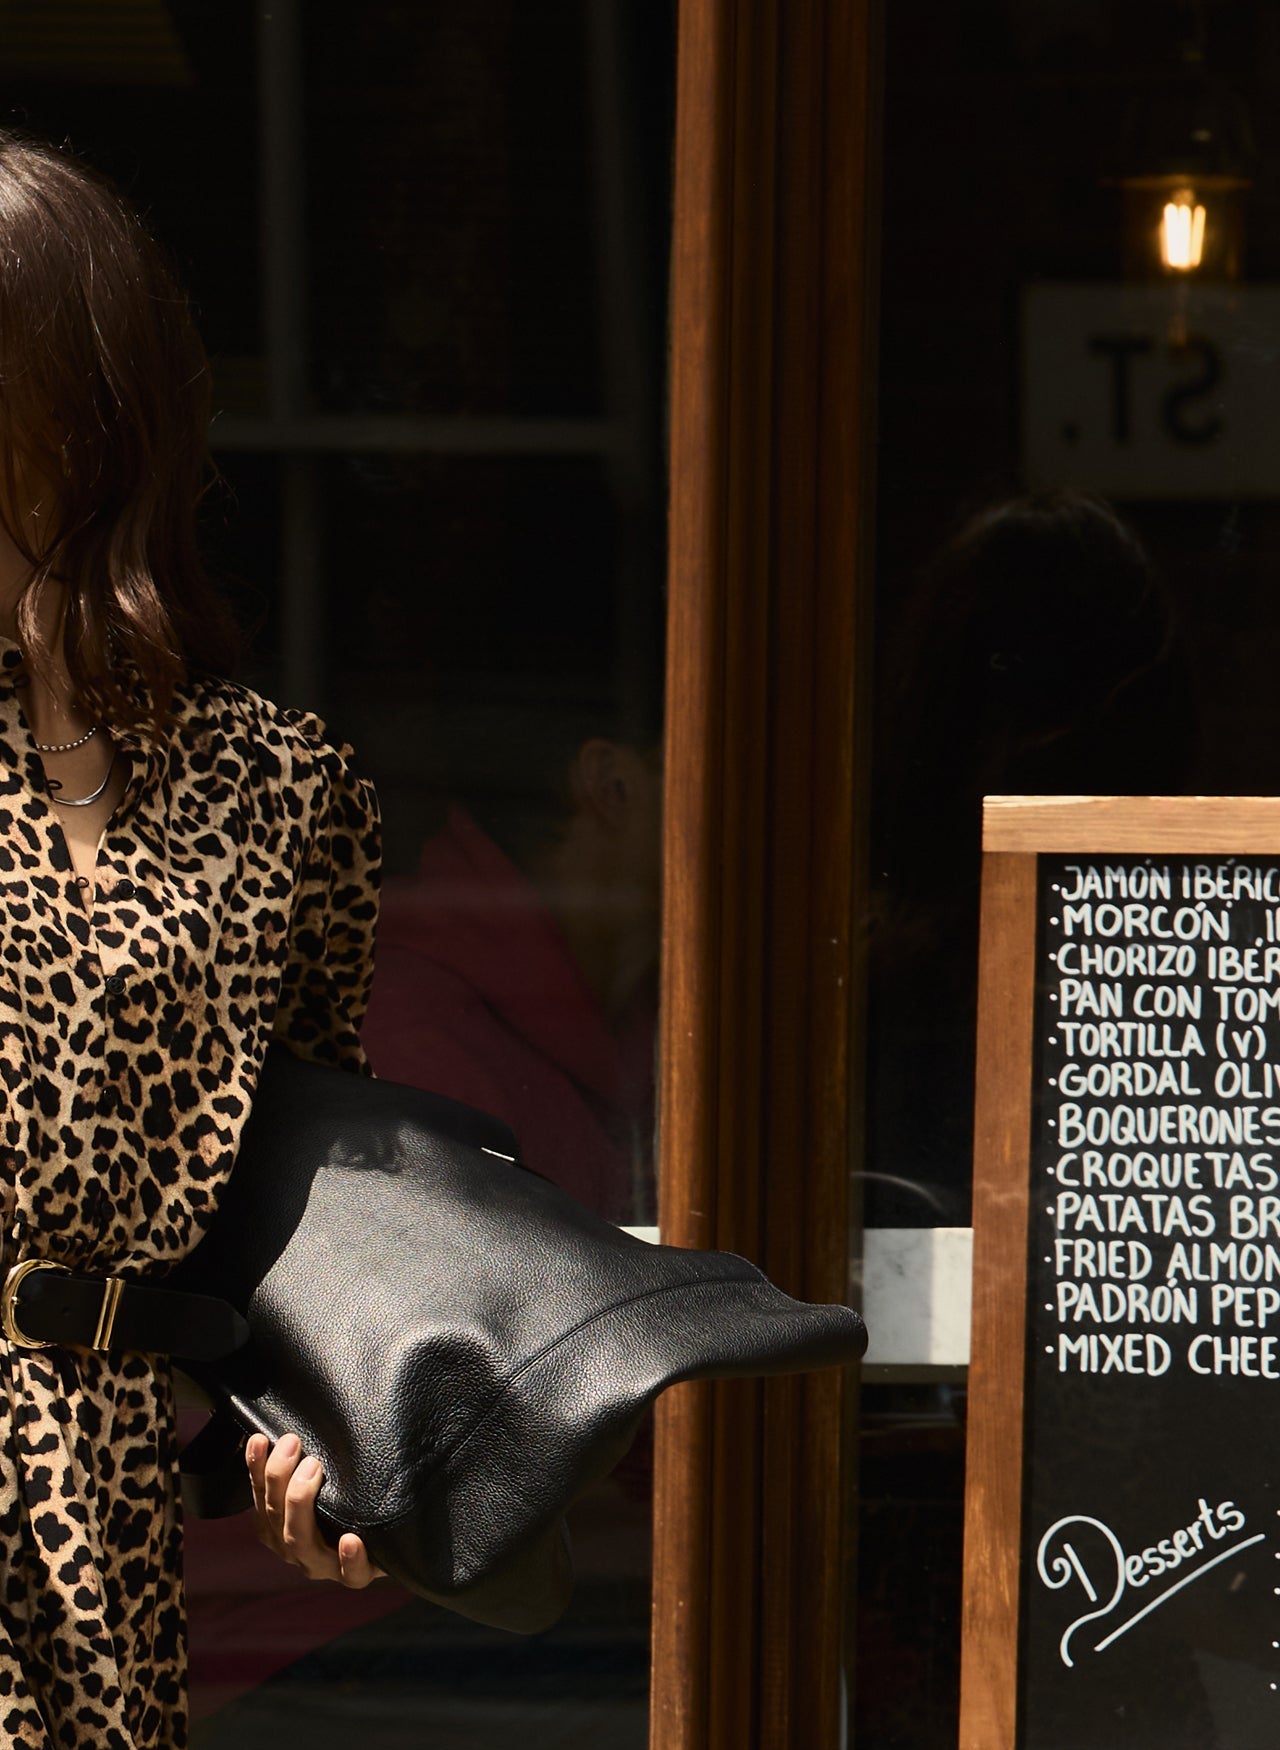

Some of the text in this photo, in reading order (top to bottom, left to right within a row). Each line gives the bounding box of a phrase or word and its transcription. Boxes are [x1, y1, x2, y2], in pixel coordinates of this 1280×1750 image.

[1061, 859, 1280, 902] JAMÓN IBÉRIC
[1063, 902, 1280, 942] MORCÓN I
[1057, 938, 1280, 983] CHORIZO IBÉR
[1059, 978, 1280, 1022] PAN CON TOM
[1056, 1022, 1206, 1058] TORTILLA
[1058, 1061, 1201, 1097] GORDAL
[1058, 1102, 1280, 1148] BOQUERONES
[1056, 1150, 1279, 1191] CROQUETAS
[1057, 1191, 1280, 1239] PATATAS BR
[1054, 1238, 1152, 1280] FRIED
[1056, 1278, 1280, 1328] PADRÓN PEP
[1058, 1333, 1280, 1378] MIXED CHEE
[1037, 1498, 1246, 1667] Desserts
